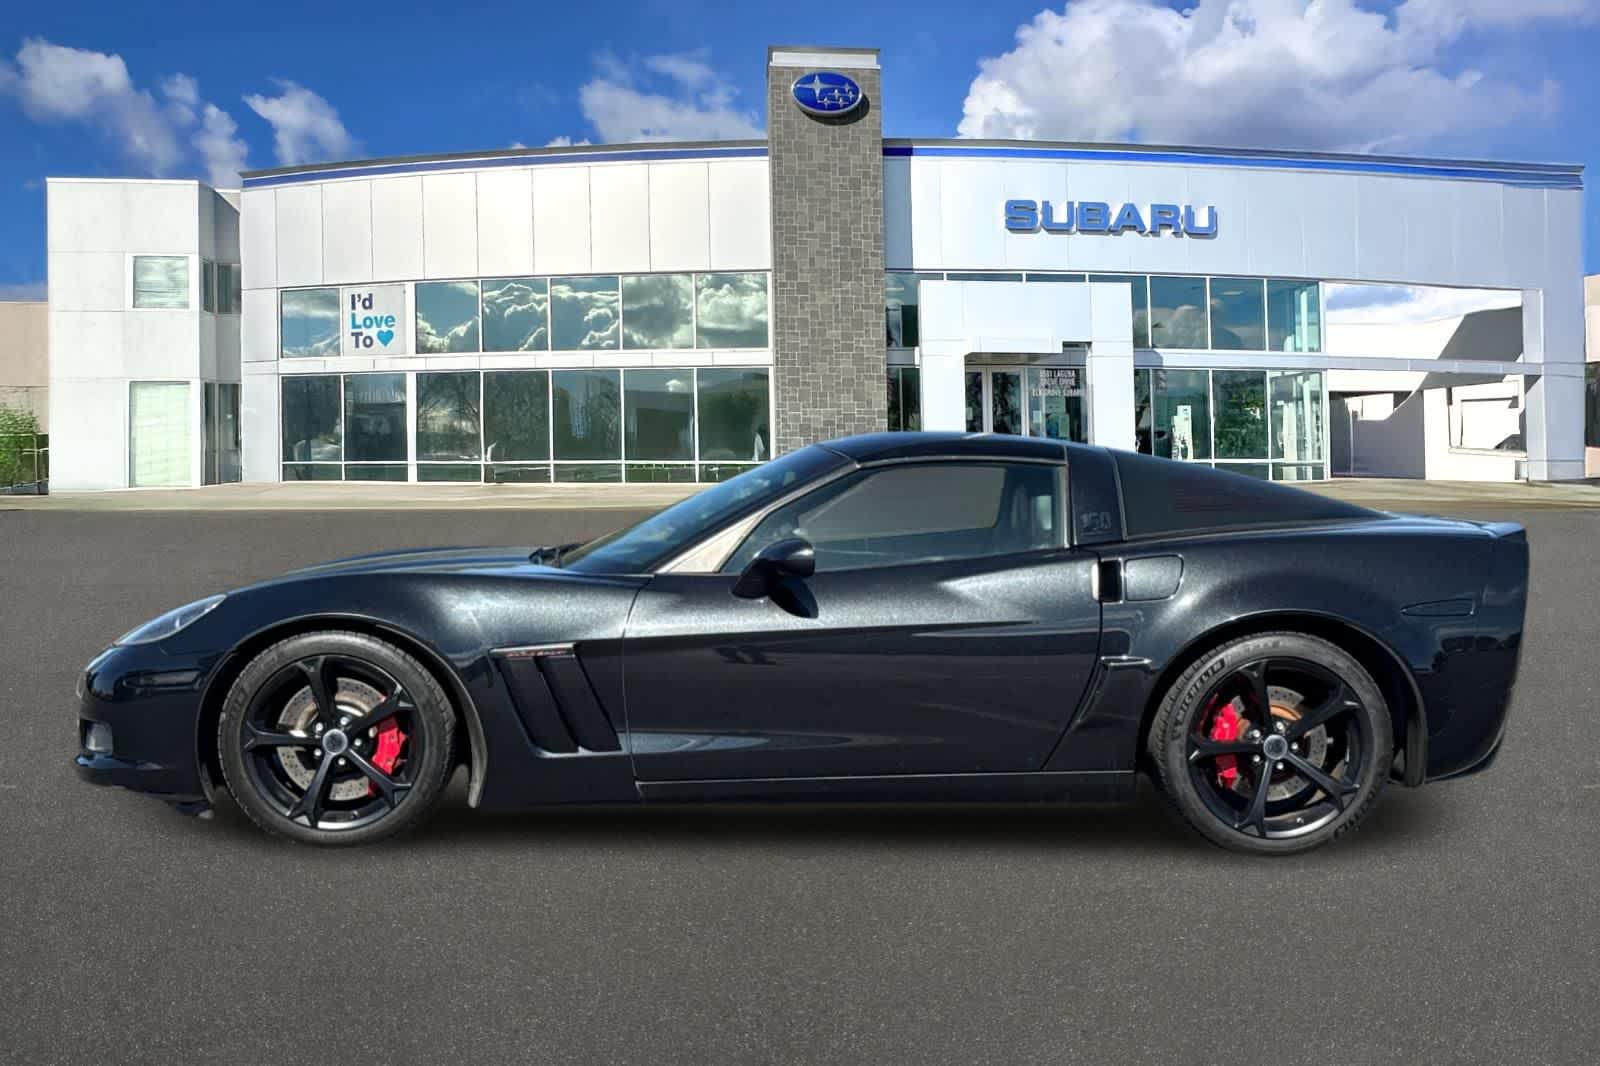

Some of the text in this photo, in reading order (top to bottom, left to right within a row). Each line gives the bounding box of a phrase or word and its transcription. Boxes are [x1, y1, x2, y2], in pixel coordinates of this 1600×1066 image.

[1004, 199, 1217, 239] SUBARU
[351, 293, 373, 310] I'd
[351, 312, 396, 329] Love
[351, 331, 374, 348] To
[1176, 659, 1223, 723] MICHELIN
